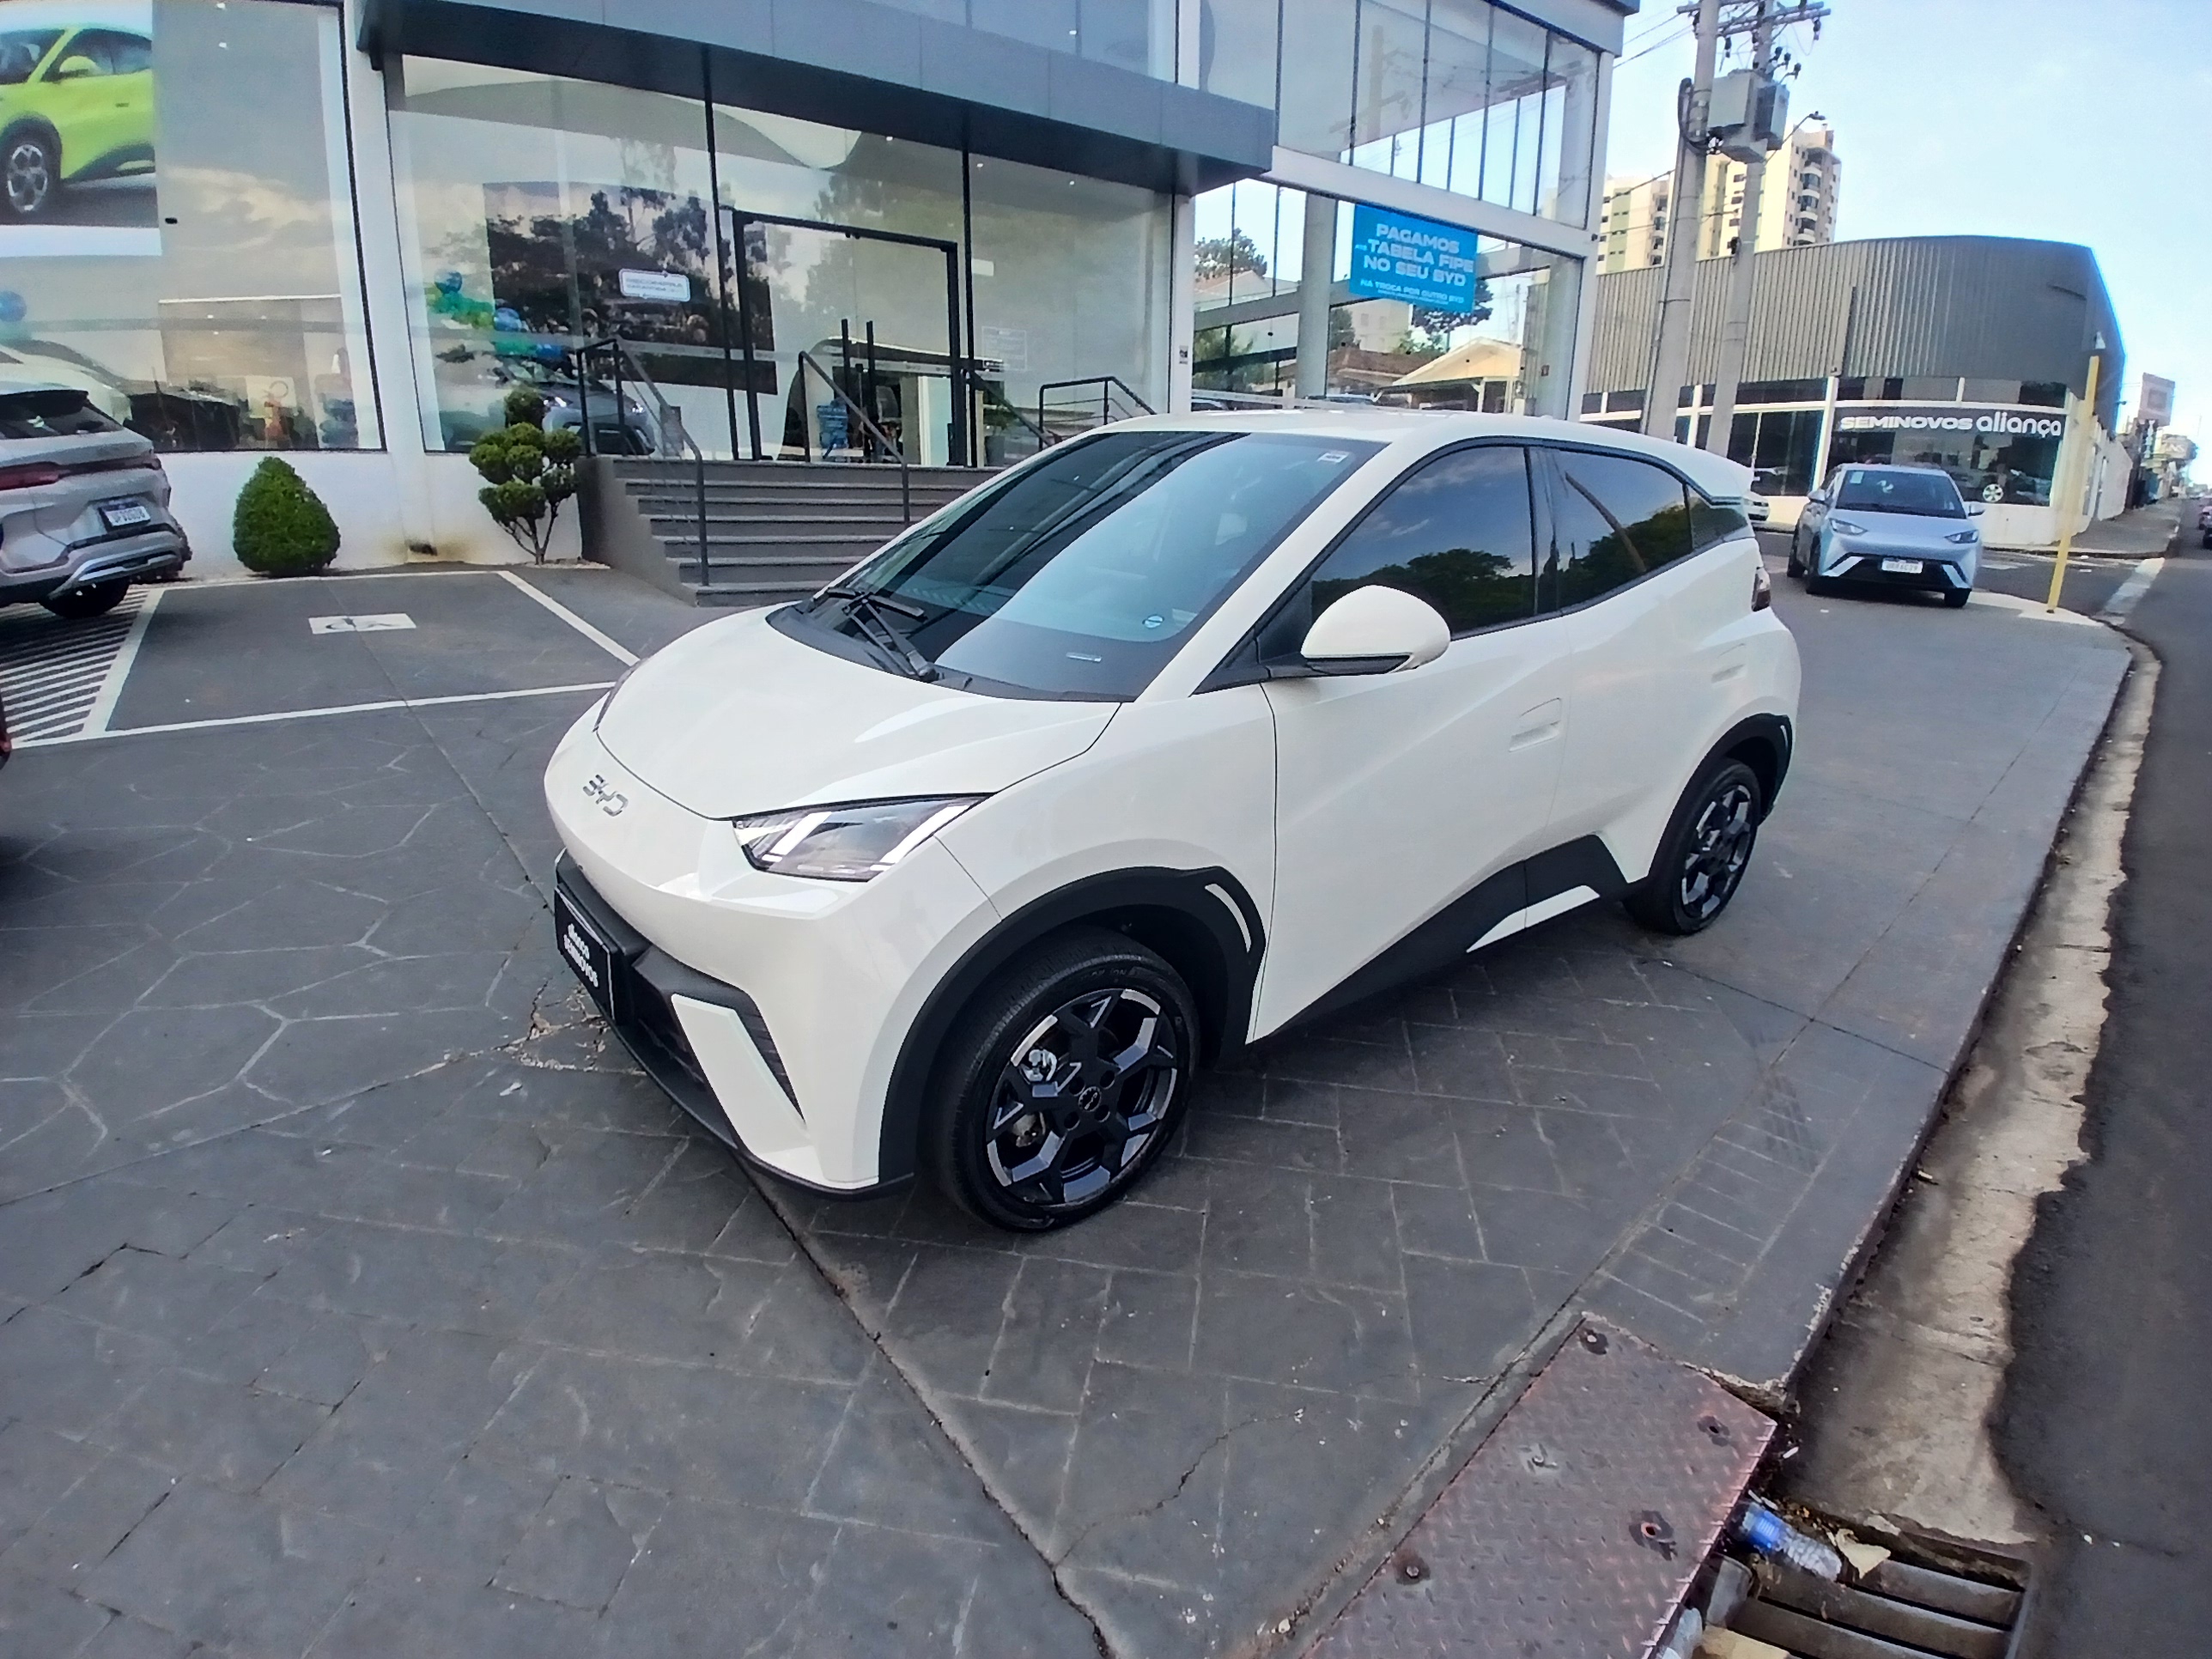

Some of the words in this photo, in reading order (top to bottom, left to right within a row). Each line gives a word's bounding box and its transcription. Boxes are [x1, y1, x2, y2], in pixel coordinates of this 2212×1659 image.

[1376, 223, 1460, 254] PAGAMOS
[1364, 255, 1390, 272] NO
[1395, 261, 1429, 279] SEU
[1433, 269, 1466, 287] BYD
[1368, 239, 1434, 265] TABELA
[1439, 254, 1474, 273] FIPE
[1360, 279, 1373, 288] NA
[1376, 282, 1401, 293] TROCA
[1403, 286, 1419, 296] POR
[1421, 289, 1448, 300] OUTRO
[1840, 416, 1973, 430] SEMINOVOS
[1976, 411, 2062, 438] aliança
[582, 774, 629, 817] BYD
